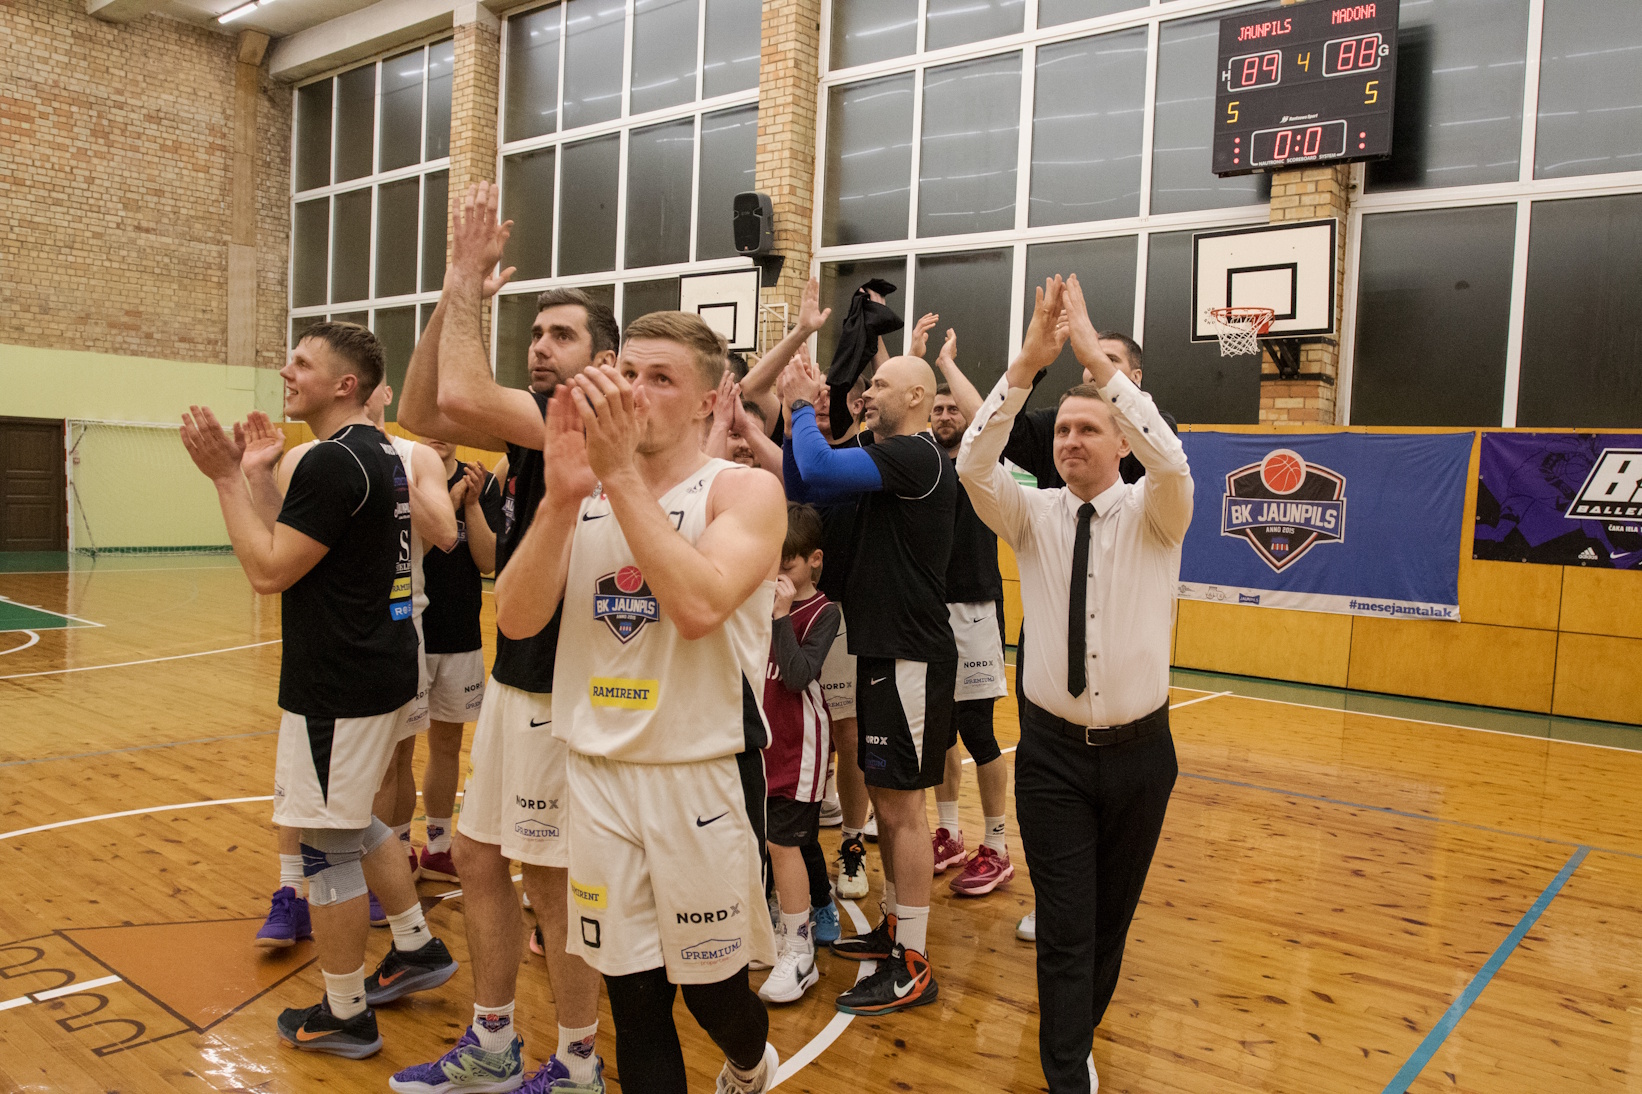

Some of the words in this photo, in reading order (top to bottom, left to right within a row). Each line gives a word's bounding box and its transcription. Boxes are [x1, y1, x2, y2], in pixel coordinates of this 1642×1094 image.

[1331, 3, 1376, 25] MADONA
[1237, 18, 1292, 41] JAUNPILS
[1297, 51, 1311, 73] 4
[1337, 36, 1378, 71] 88
[1221, 70, 1231, 82] H
[1241, 53, 1279, 86] 89
[1364, 80, 1379, 104] 5
[1226, 101, 1240, 124] 5
[1273, 126, 1322, 160] 0:0
[1258, 158, 1285, 166] NAUTRONIC
[1286, 155, 1317, 164] SCOREBOARD
[1231, 504, 1253, 524] BK
[1257, 502, 1338, 529] JAUNPILS
[1282, 526, 1295, 534] 2015
[1608, 524, 1625, 532] ČAKA
[1625, 525, 1639, 533] IELA
[596, 599, 610, 613] BK
[1349, 599, 1452, 618] #mesejamtalak
[593, 685, 650, 700] RAMIRENT
[828, 699, 852, 707] REMIUM
[685, 941, 739, 960] PREMIUM
